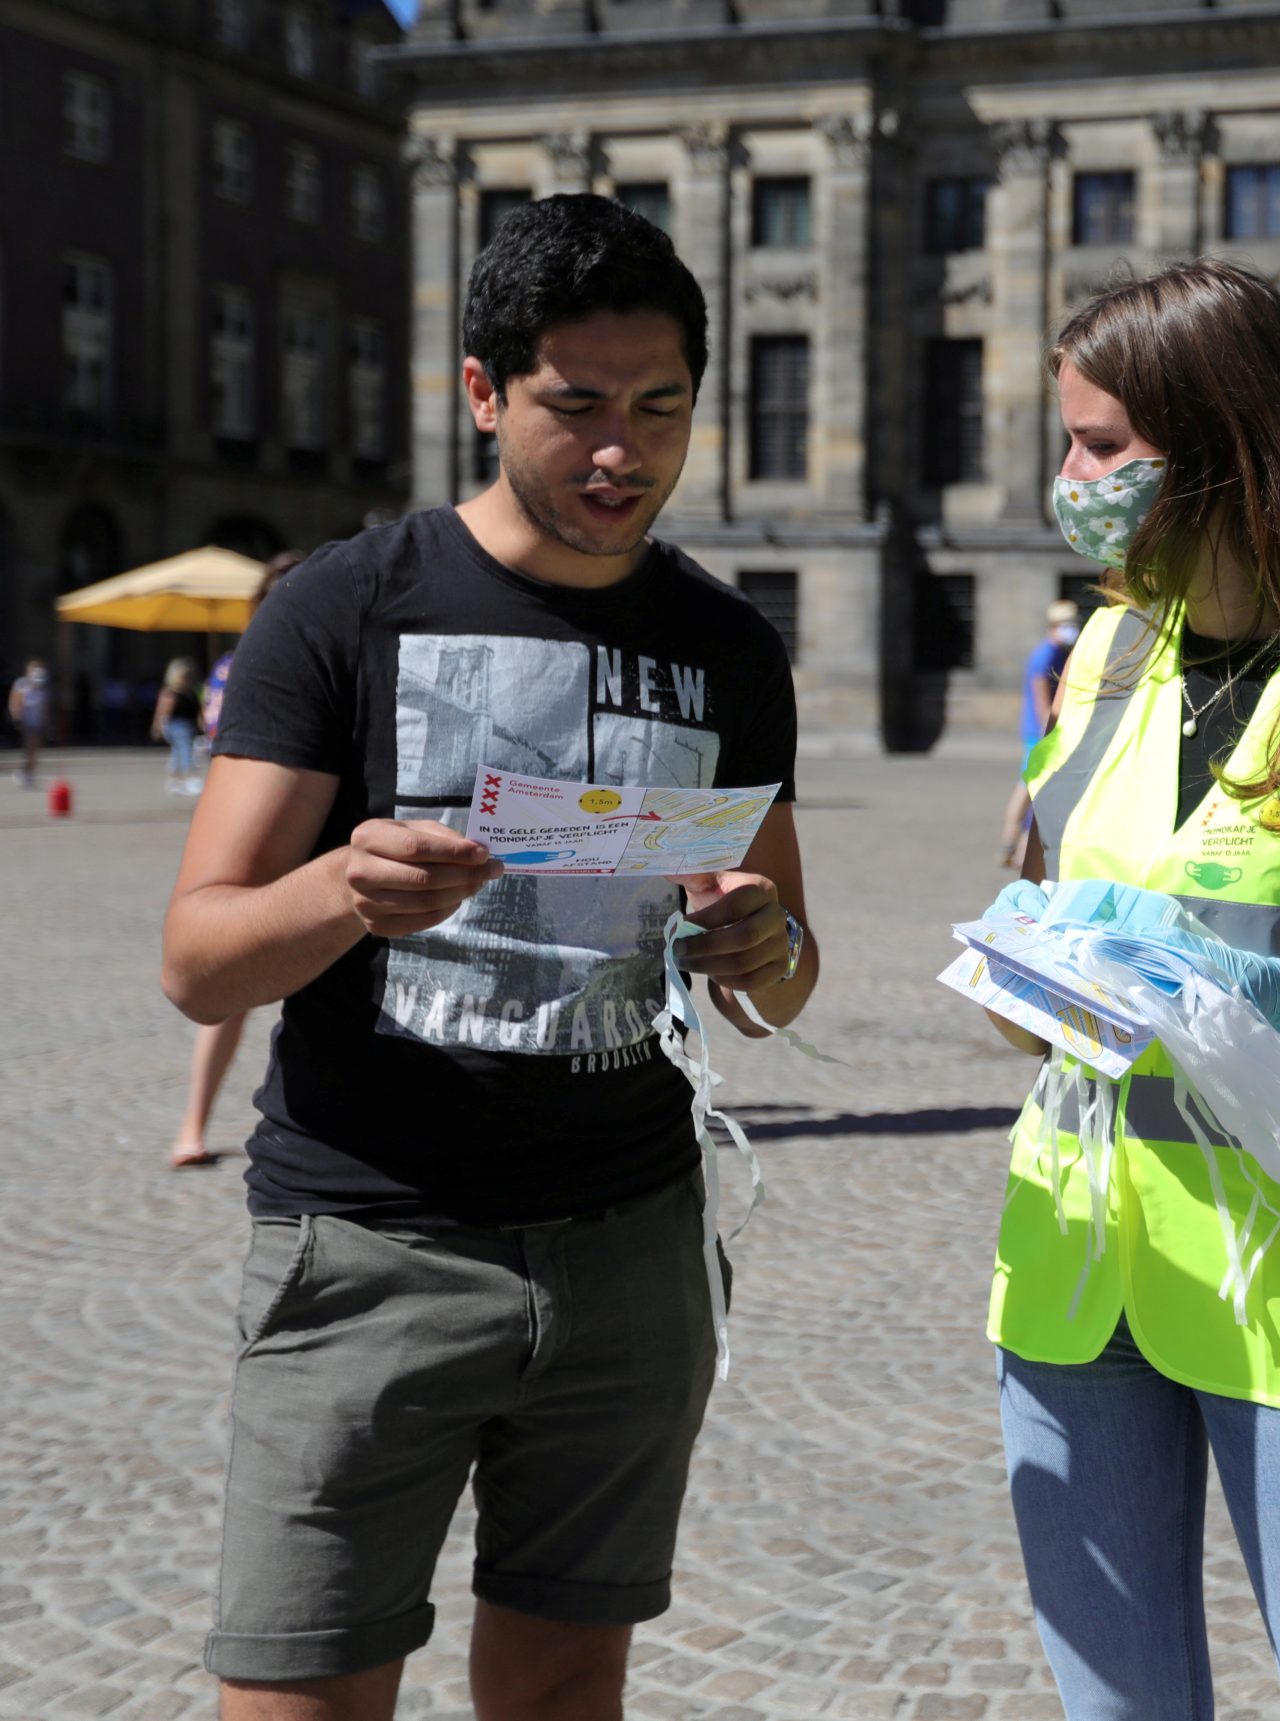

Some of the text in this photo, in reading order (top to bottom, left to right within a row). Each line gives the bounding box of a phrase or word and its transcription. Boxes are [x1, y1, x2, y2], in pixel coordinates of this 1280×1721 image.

[596, 644, 706, 722] NEW
[509, 779, 560, 793] Gemeente
[508, 787, 564, 800] Amsterdam
[479, 825, 490, 833] IN
[493, 826, 506, 834] DE
[508, 827, 536, 835] GELE
[539, 825, 590, 834] GEBIEDEN
[558, 829, 618, 839] VERPLICHT
[1202, 837, 1255, 846] VERPLICHT
[571, 1040, 652, 1074] BROOKLYN
